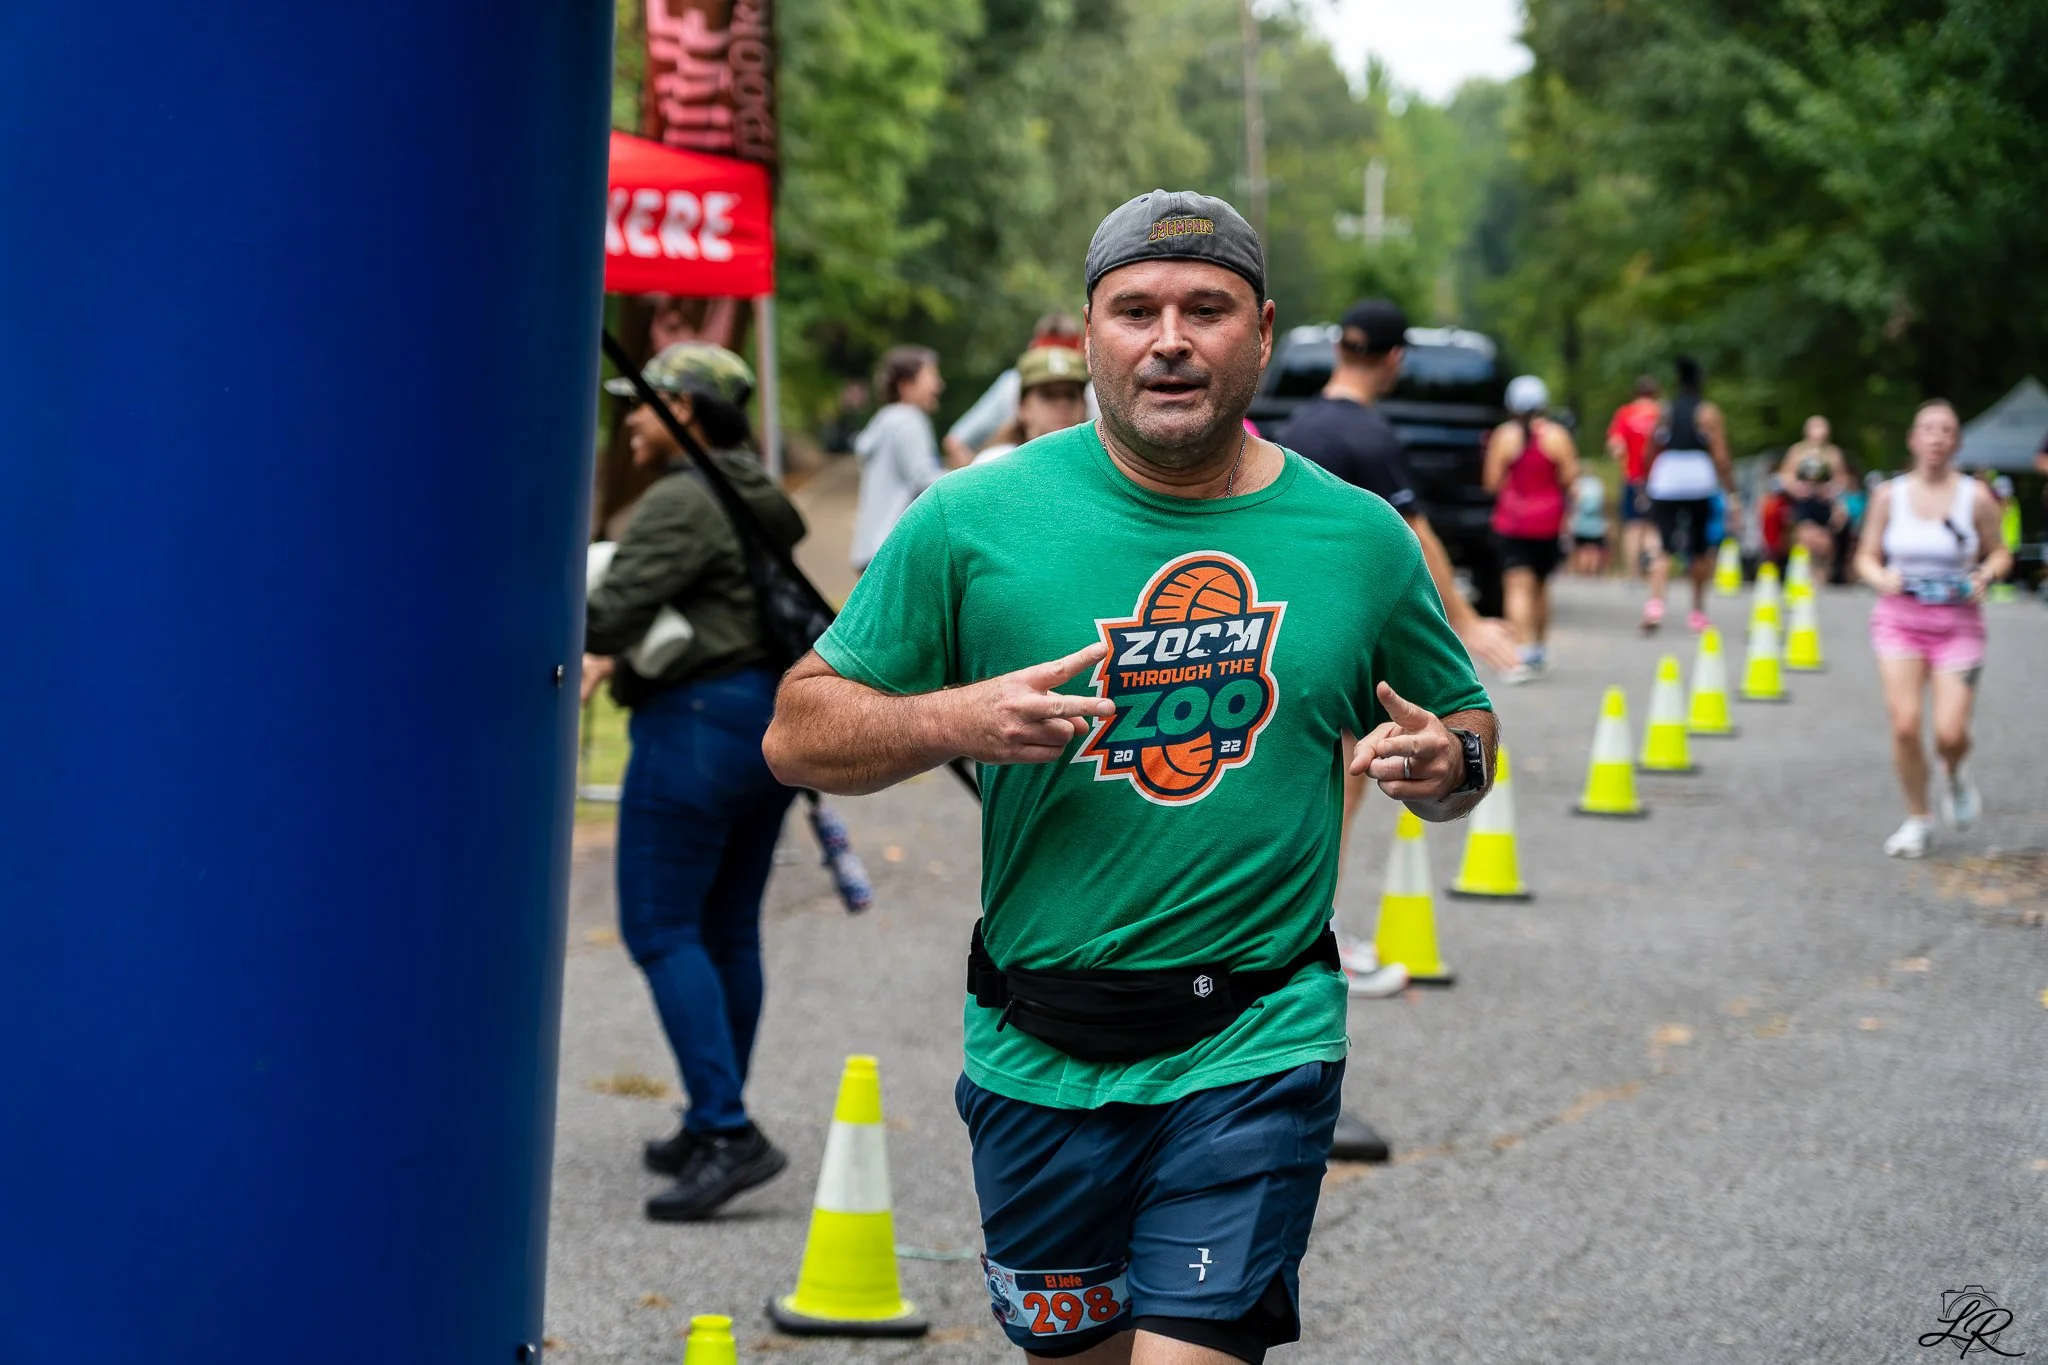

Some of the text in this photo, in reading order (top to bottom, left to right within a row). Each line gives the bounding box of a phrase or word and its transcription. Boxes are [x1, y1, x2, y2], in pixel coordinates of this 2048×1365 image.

[1149, 219, 1214, 242] MEMPHIS
[1119, 657, 1256, 688] THROUGH THE
[1106, 679, 1263, 743] ZOO
[1113, 739, 1242, 763] 20 22
[1044, 1274, 1057, 1289] El
[1023, 1285, 1120, 1334] 298
